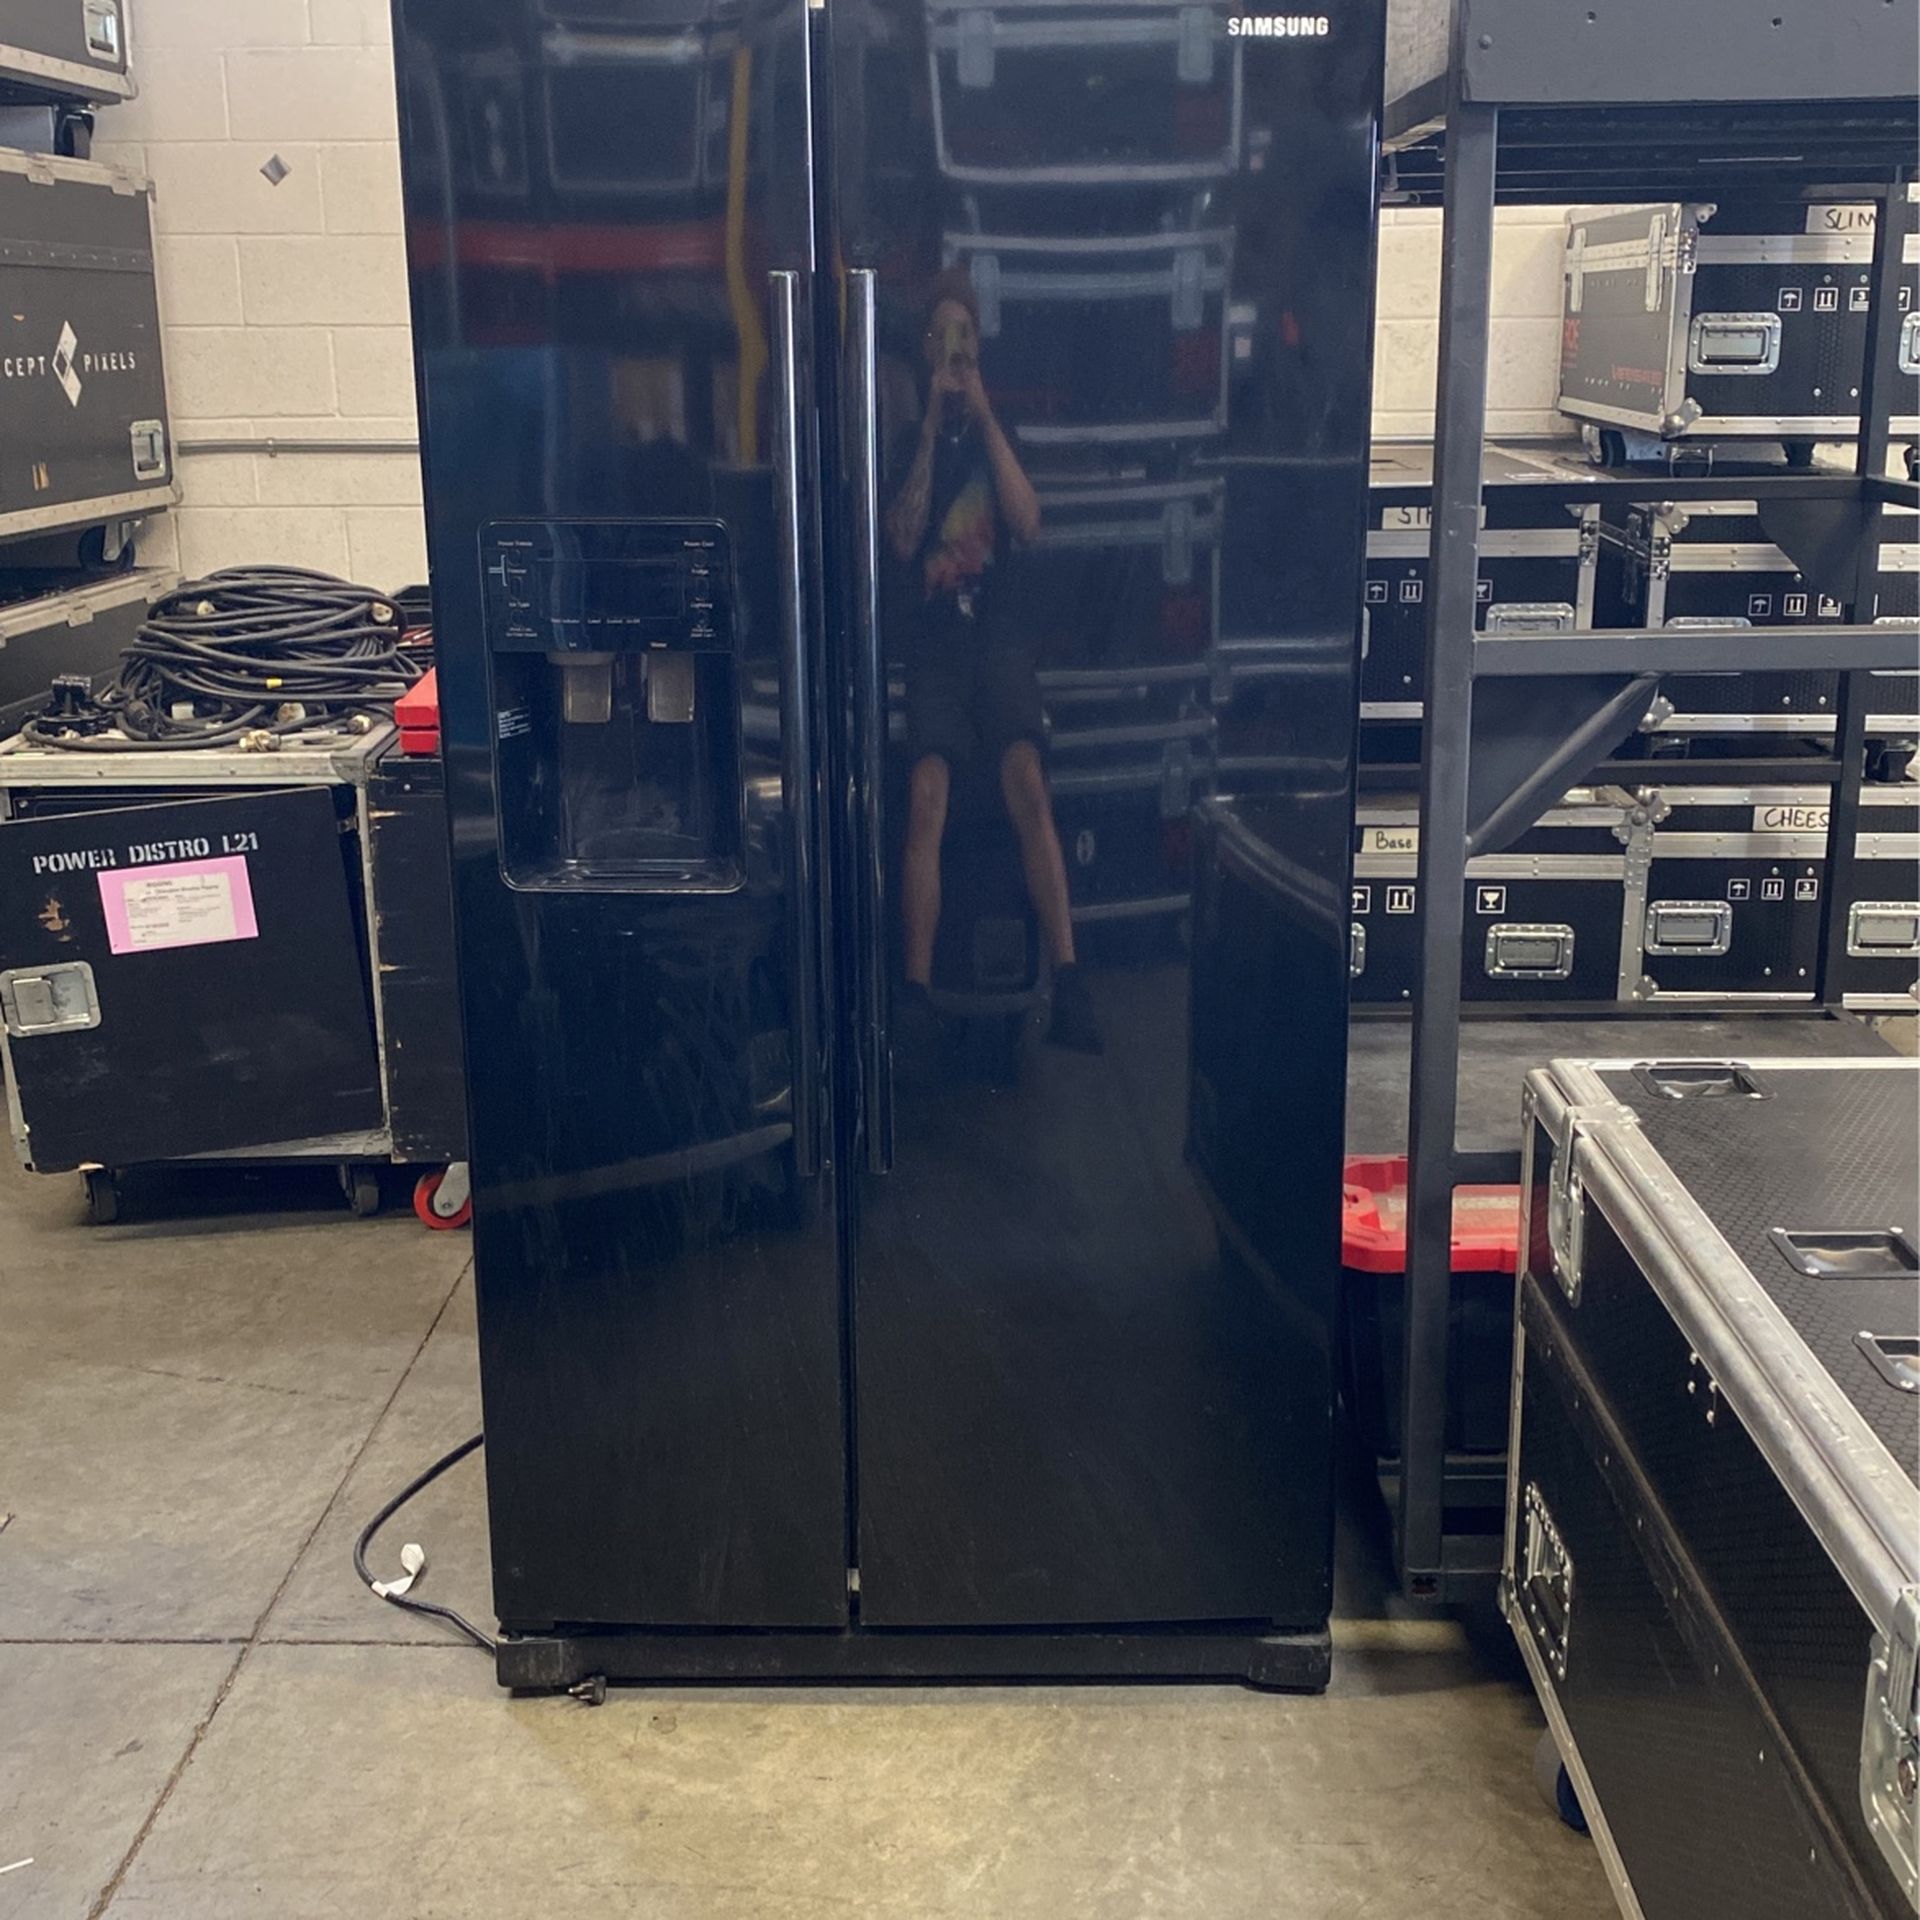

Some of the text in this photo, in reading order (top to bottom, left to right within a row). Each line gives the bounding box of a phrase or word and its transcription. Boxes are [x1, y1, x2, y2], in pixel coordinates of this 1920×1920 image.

[1227, 16, 1329, 37] SAMSUNG
[83, 351, 136, 373] PIXELS
[1376, 830, 1412, 850] Base
[32, 848, 117, 875] POWER
[129, 837, 210, 864] DISTRO
